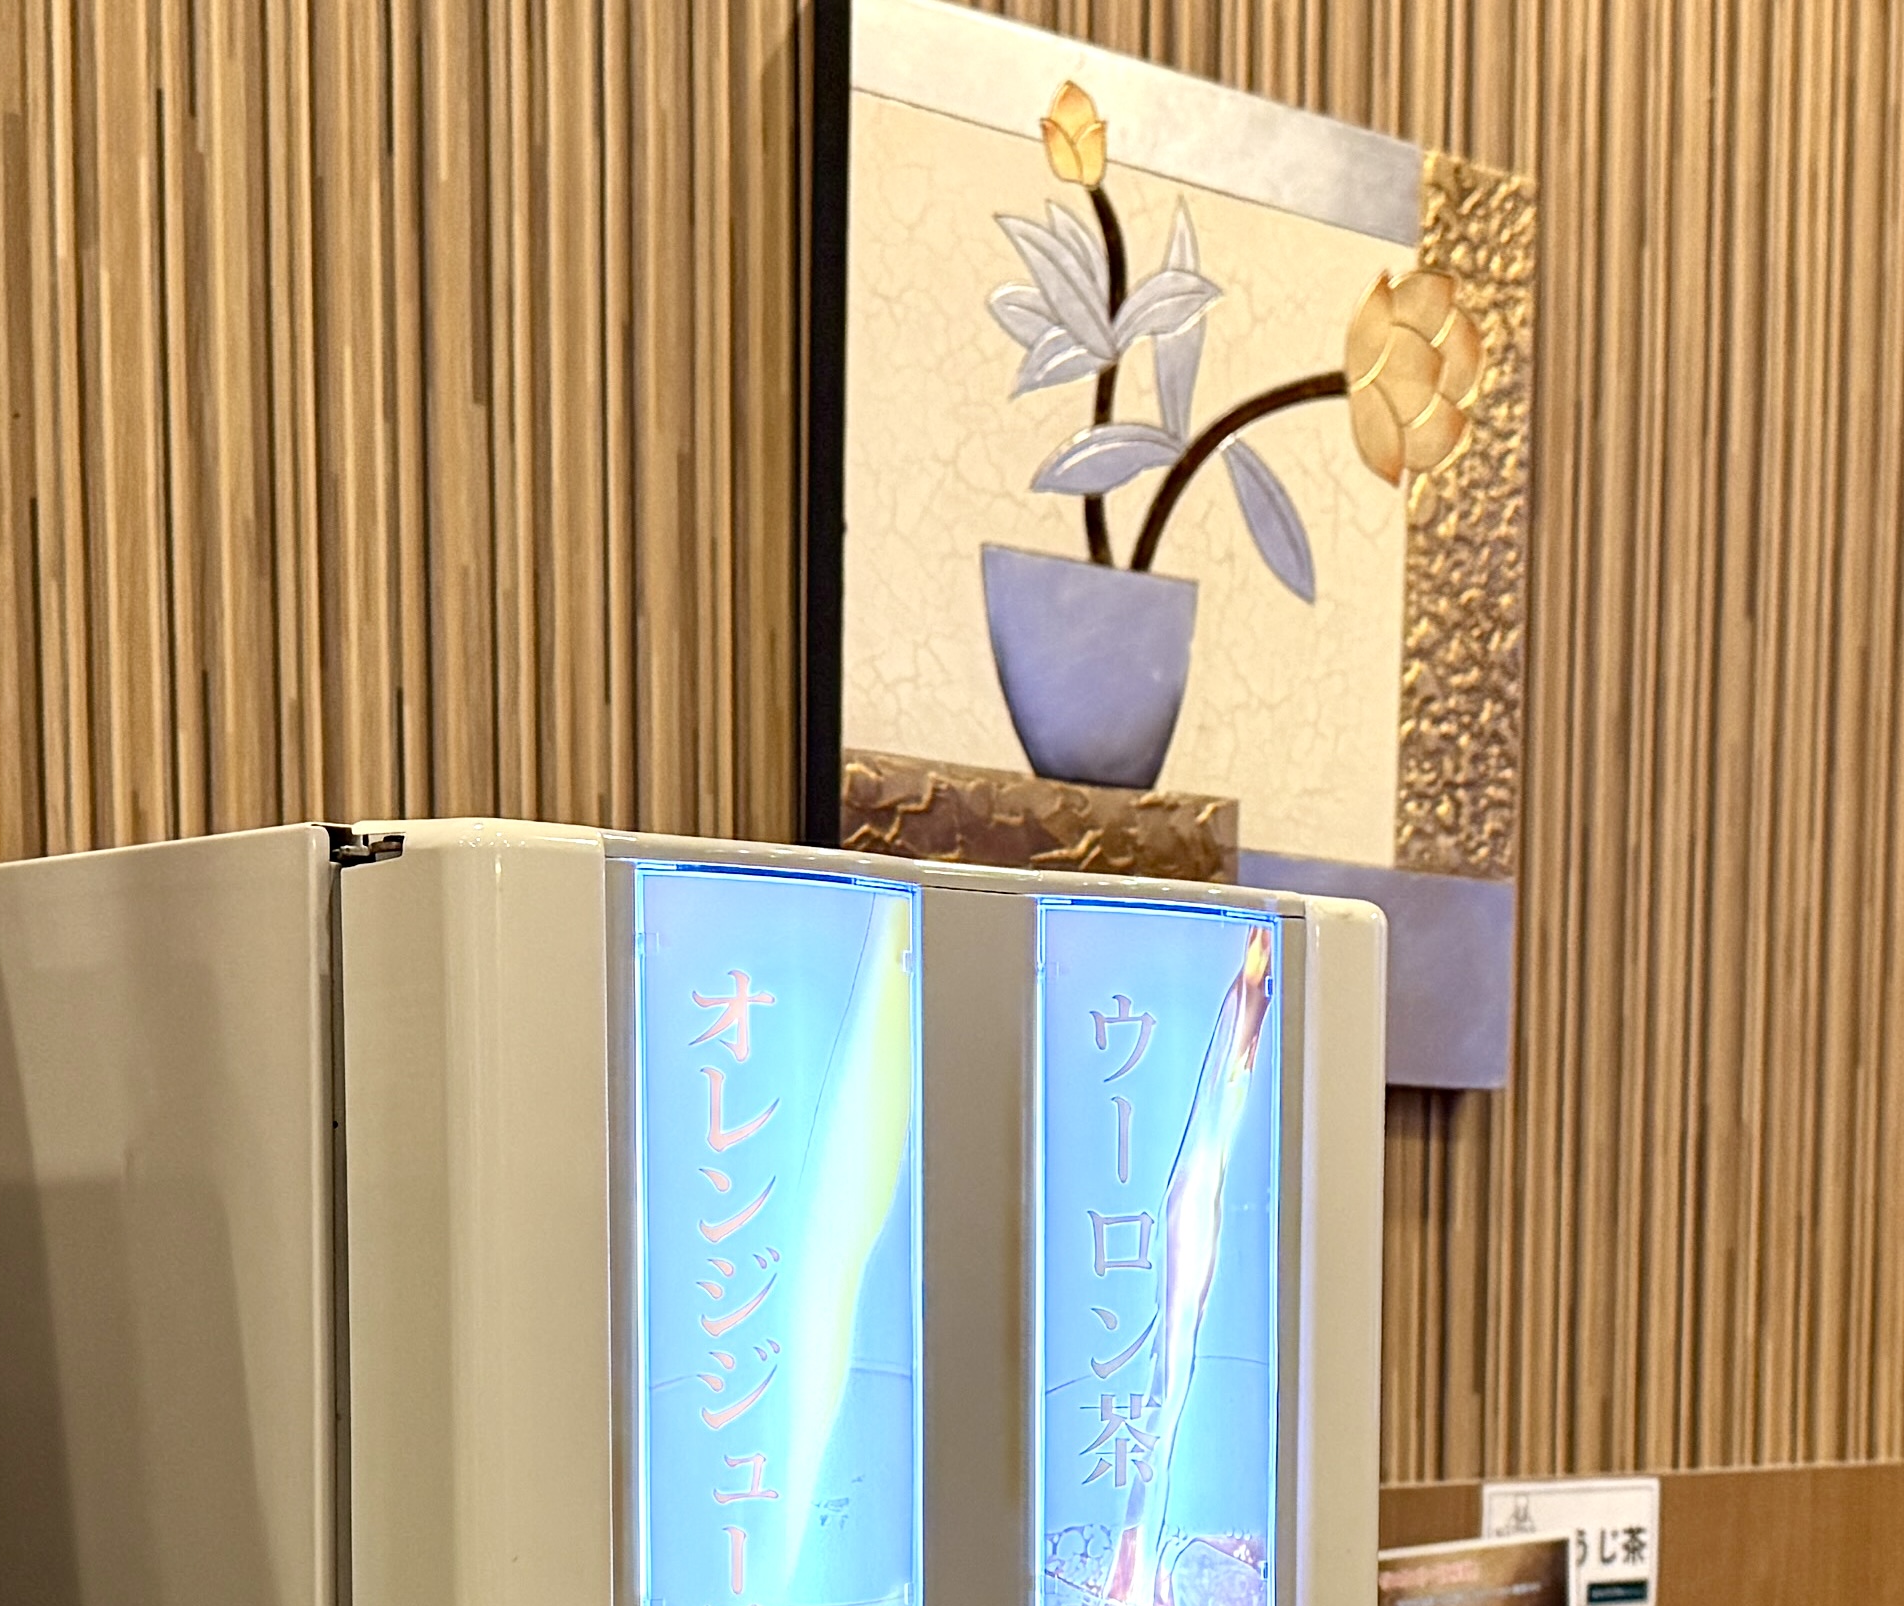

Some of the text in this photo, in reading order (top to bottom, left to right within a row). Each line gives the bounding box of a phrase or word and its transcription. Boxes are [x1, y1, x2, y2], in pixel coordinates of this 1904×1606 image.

[1078, 993, 1163, 1489] ウーロン茶
